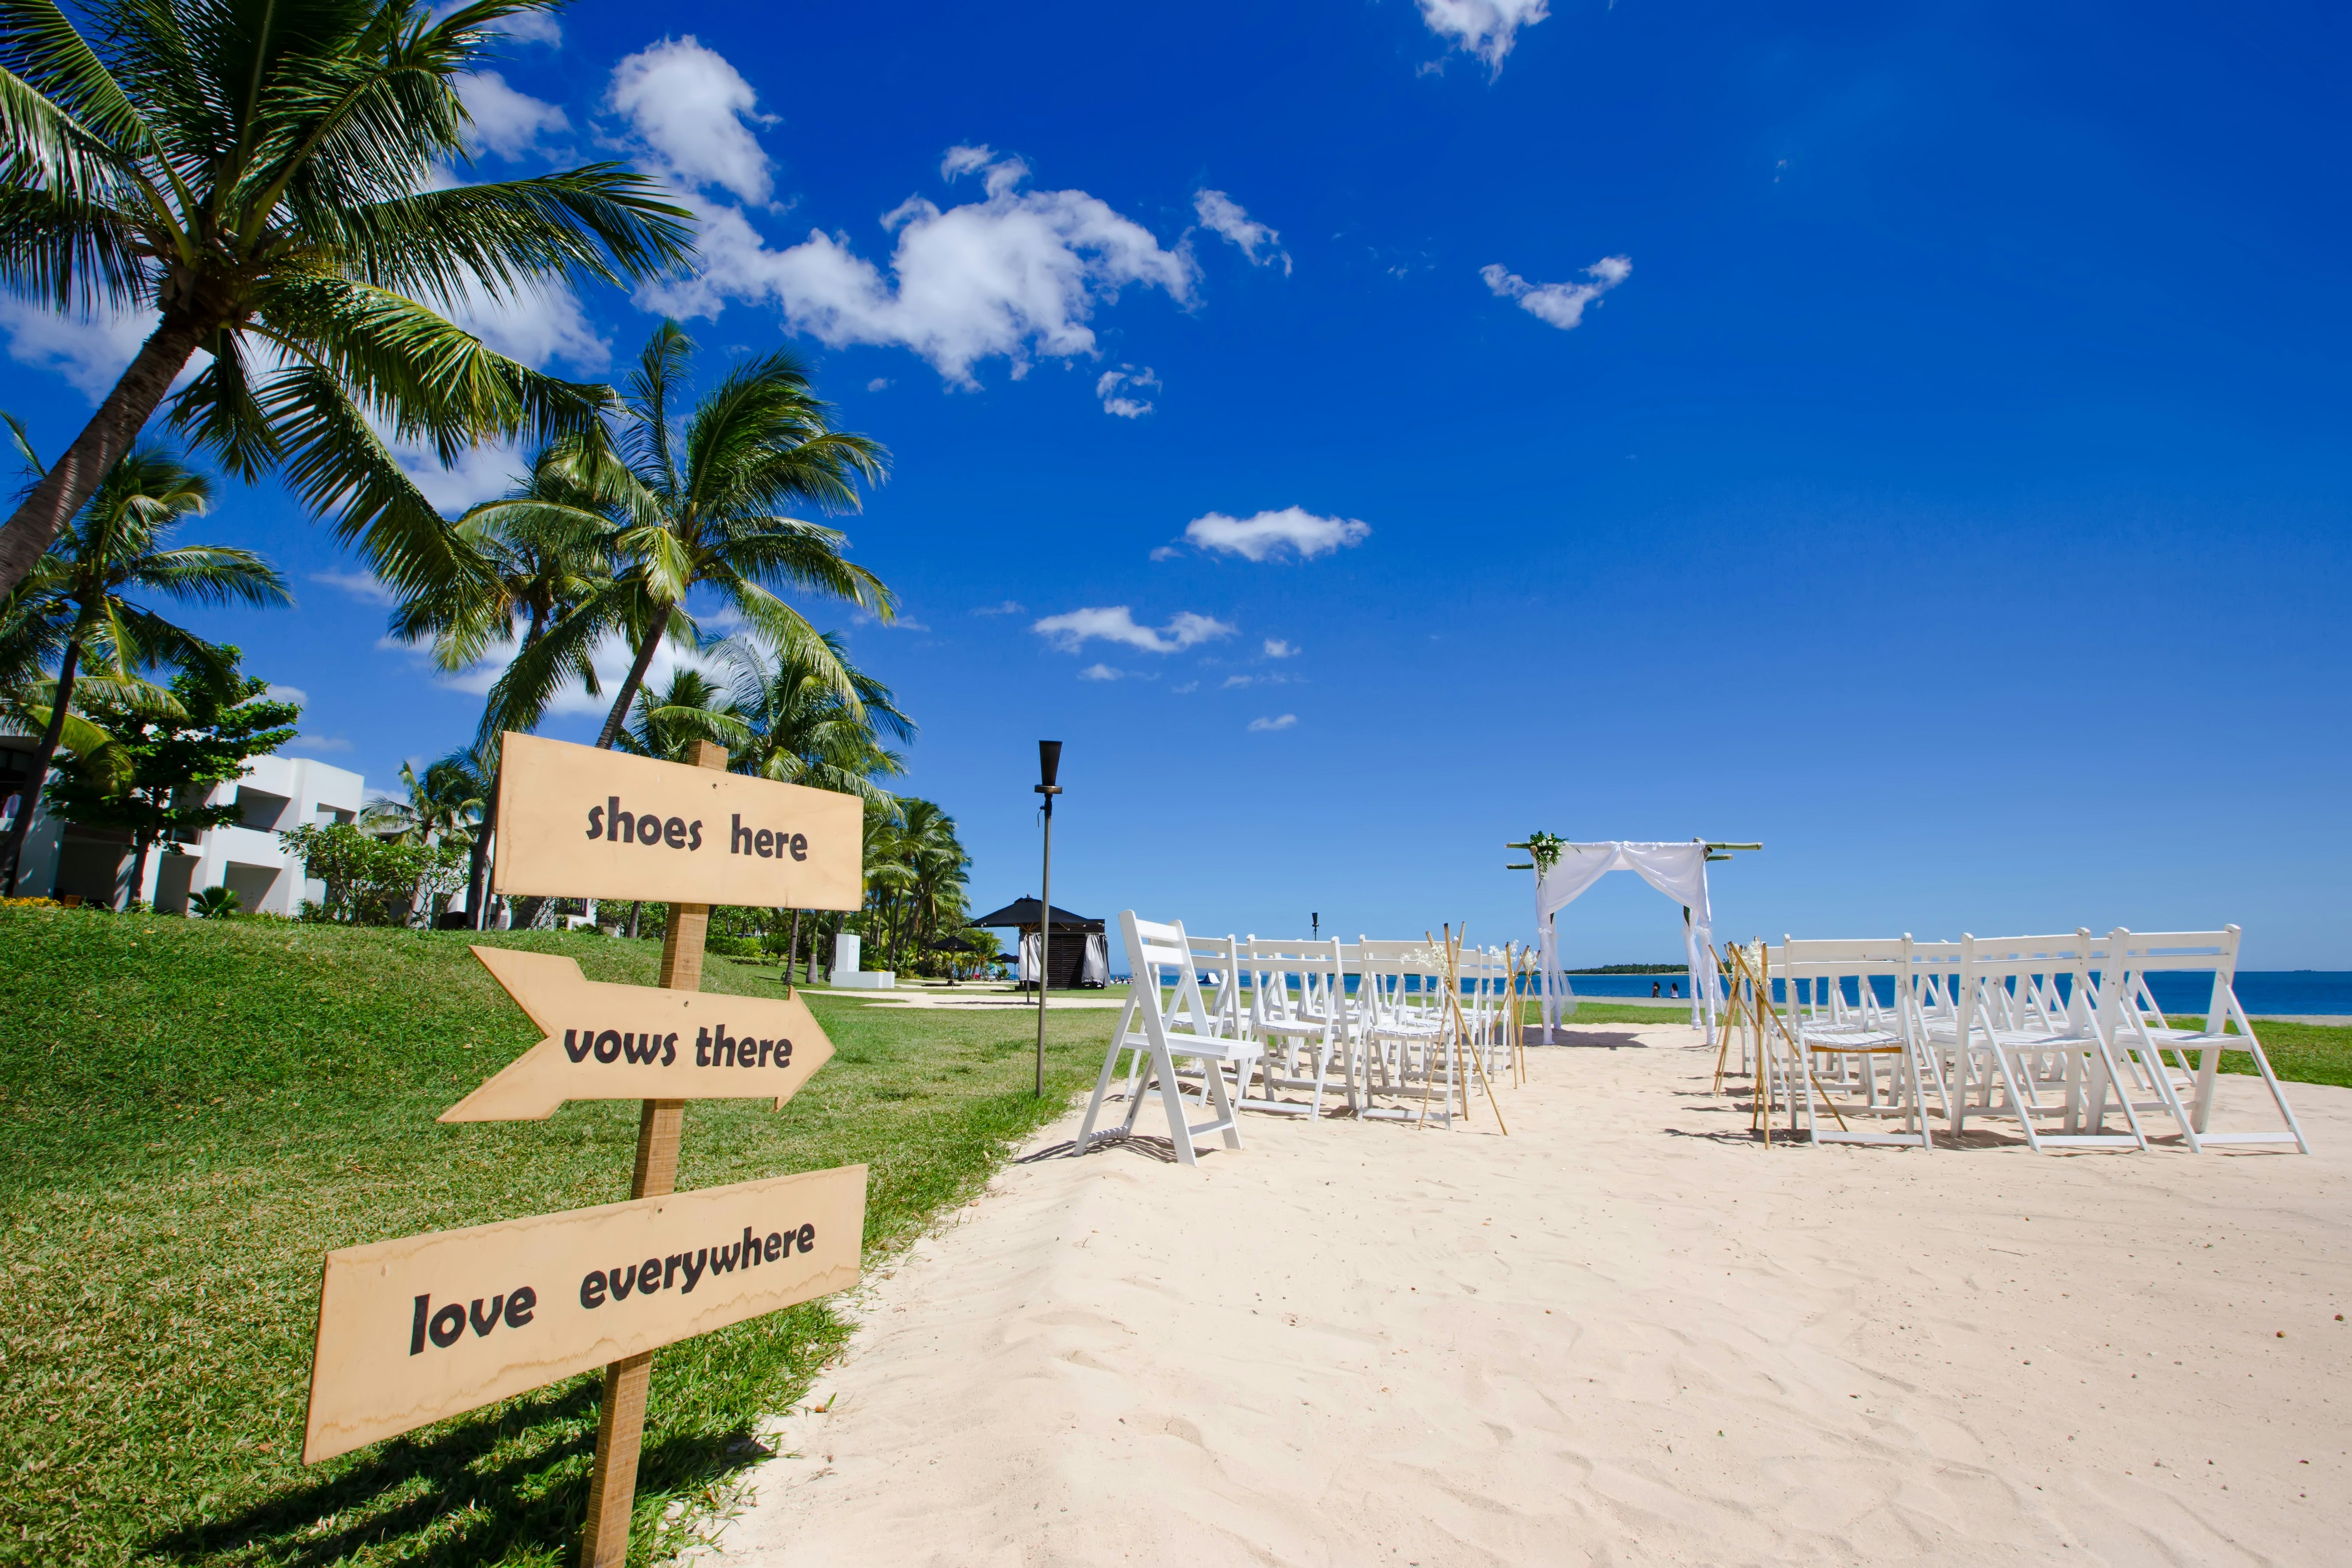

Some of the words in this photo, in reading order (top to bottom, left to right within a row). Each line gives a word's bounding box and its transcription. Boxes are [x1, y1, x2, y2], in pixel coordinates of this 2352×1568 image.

[586, 796, 702, 851] shoes
[731, 814, 807, 861] here
[564, 1029, 677, 1066] vows
[696, 1025, 792, 1068] there
[410, 1287, 536, 1356] love
[581, 1224, 815, 1309] everywhere
